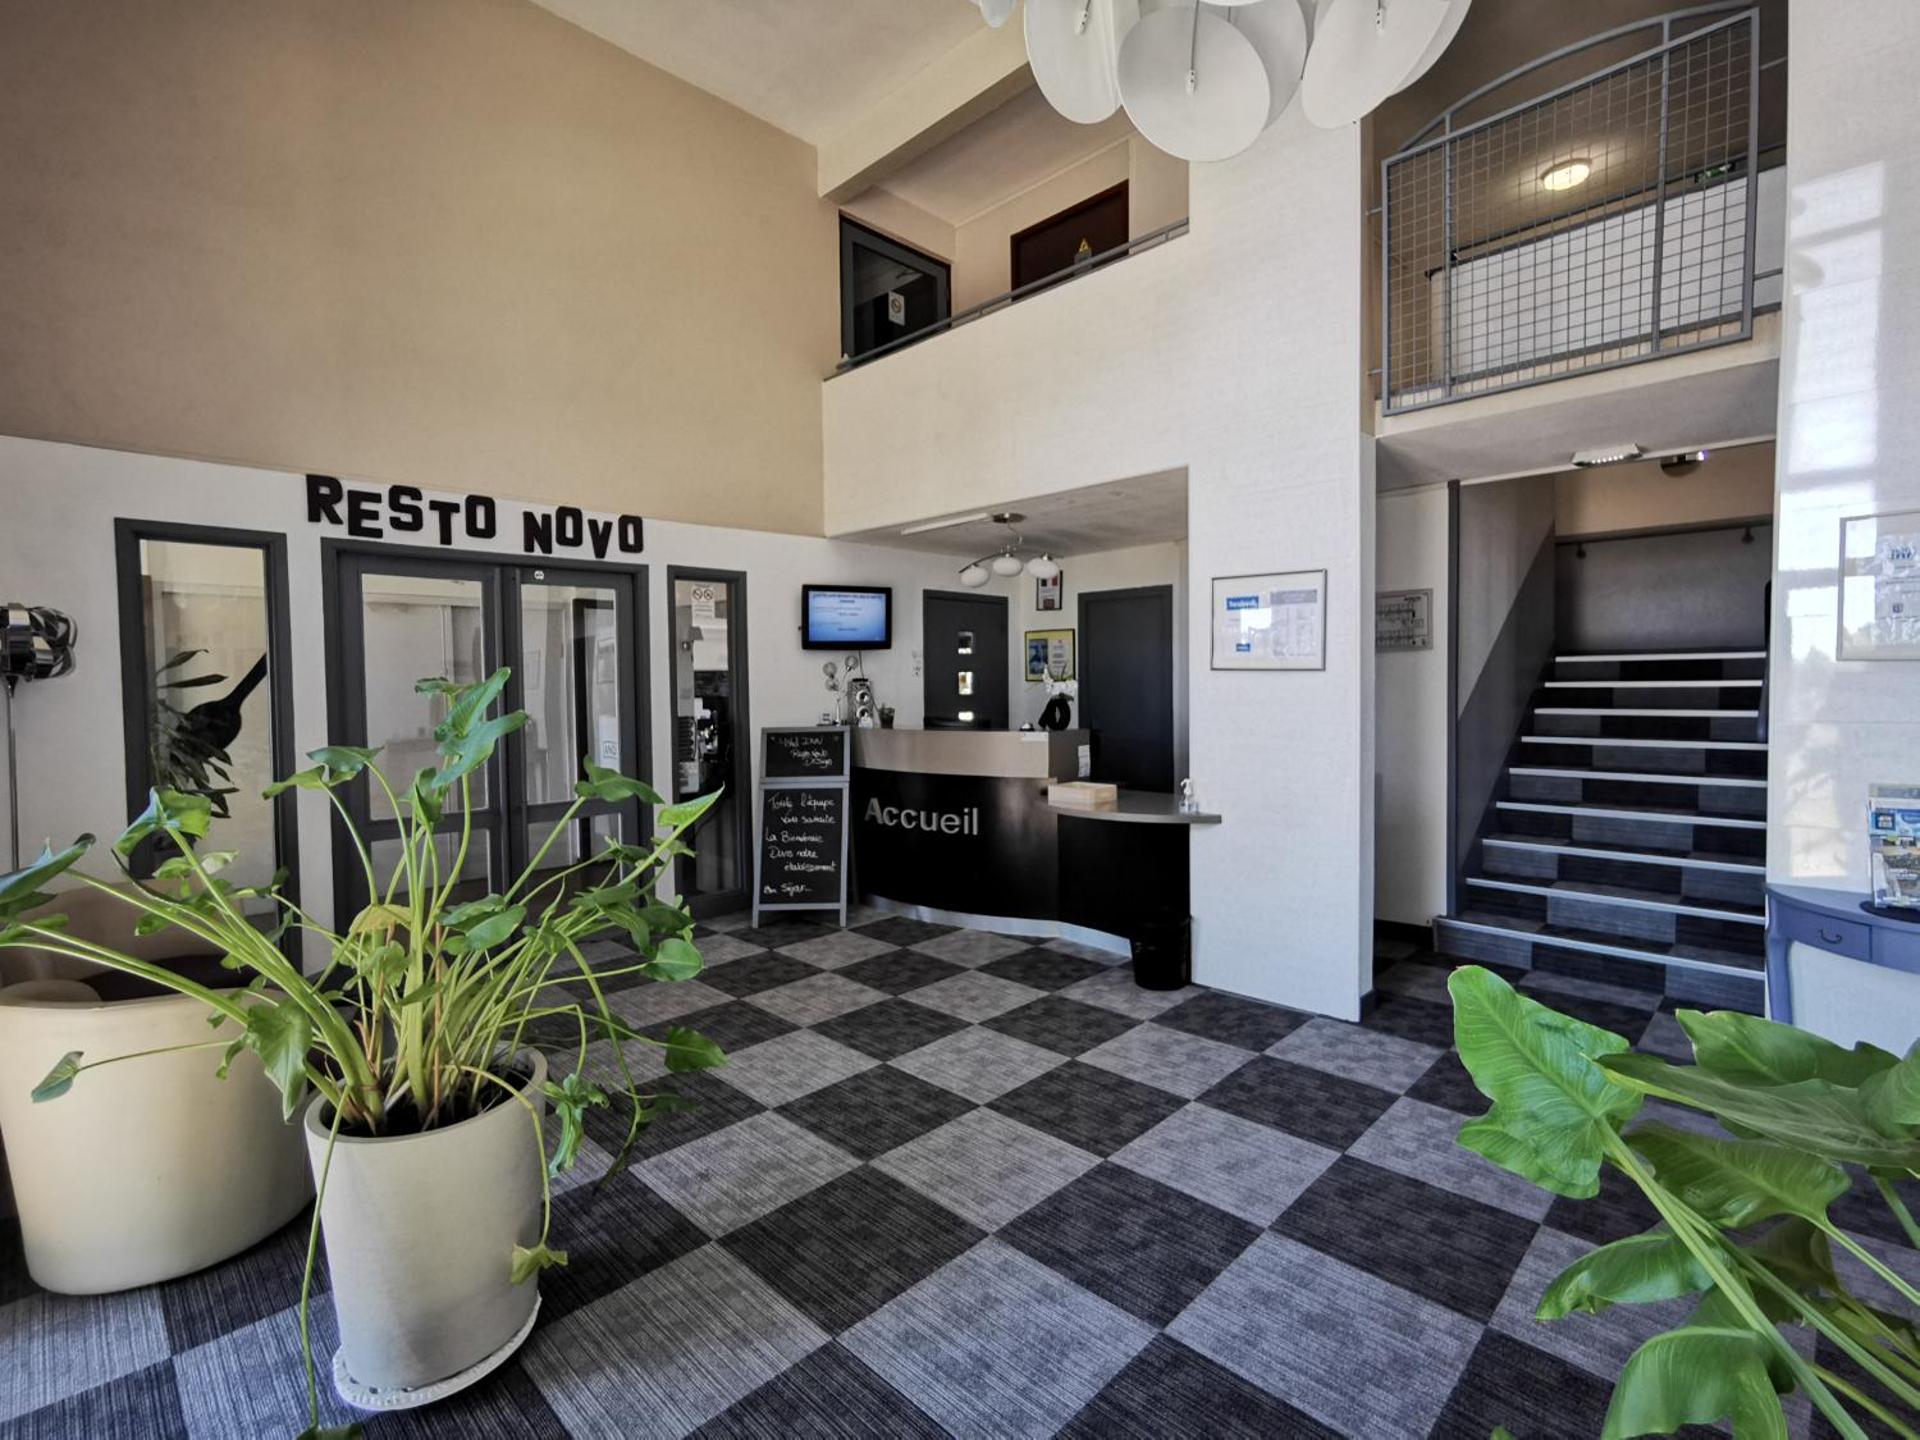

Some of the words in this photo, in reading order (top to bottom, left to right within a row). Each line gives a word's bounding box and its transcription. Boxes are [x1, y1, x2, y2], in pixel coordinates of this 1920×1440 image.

[306, 474, 496, 545] RESTO
[523, 506, 644, 559] NOVO
[864, 797, 978, 835] Accueil
